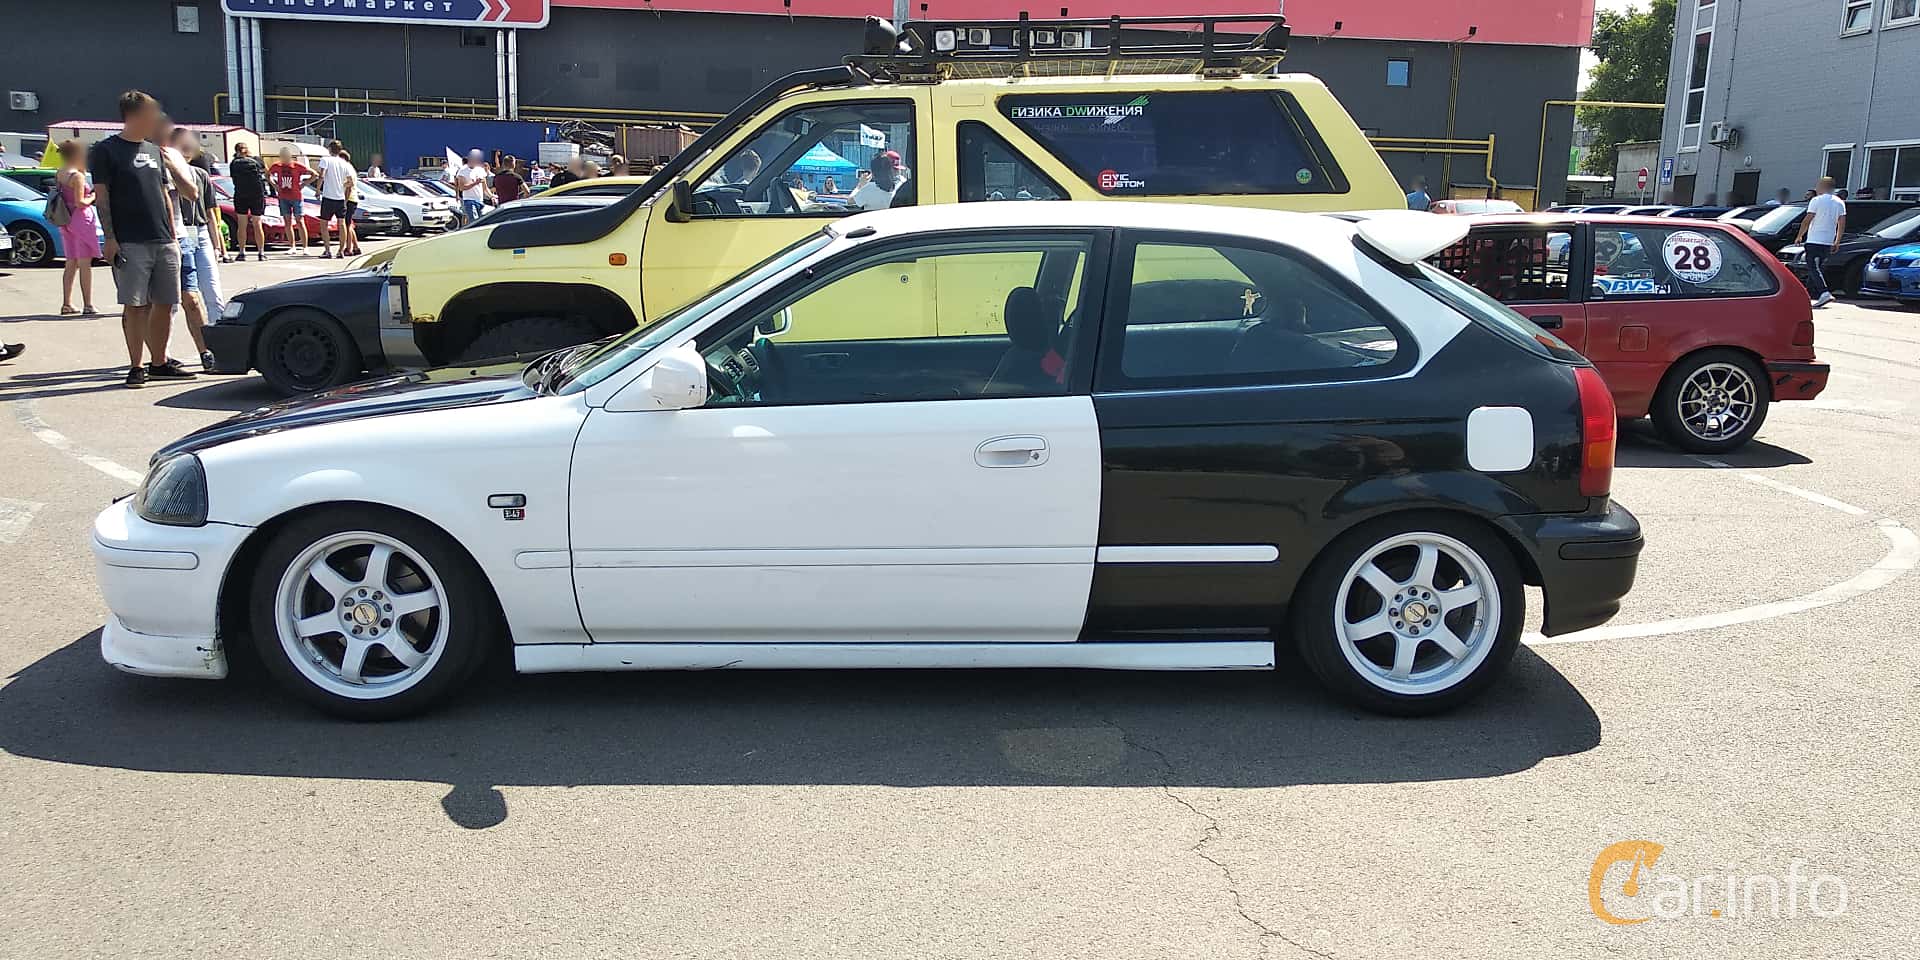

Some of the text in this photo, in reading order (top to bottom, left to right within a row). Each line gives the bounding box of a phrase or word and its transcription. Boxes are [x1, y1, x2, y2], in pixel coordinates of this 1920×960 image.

[1066, 105, 1143, 117] DWИЖЕНИЯ
[1102, 173, 1129, 181] CIVIC
[1102, 180, 1145, 188] CUSTOM
[1674, 245, 1711, 270] 28
[1611, 280, 1653, 291] BVS
